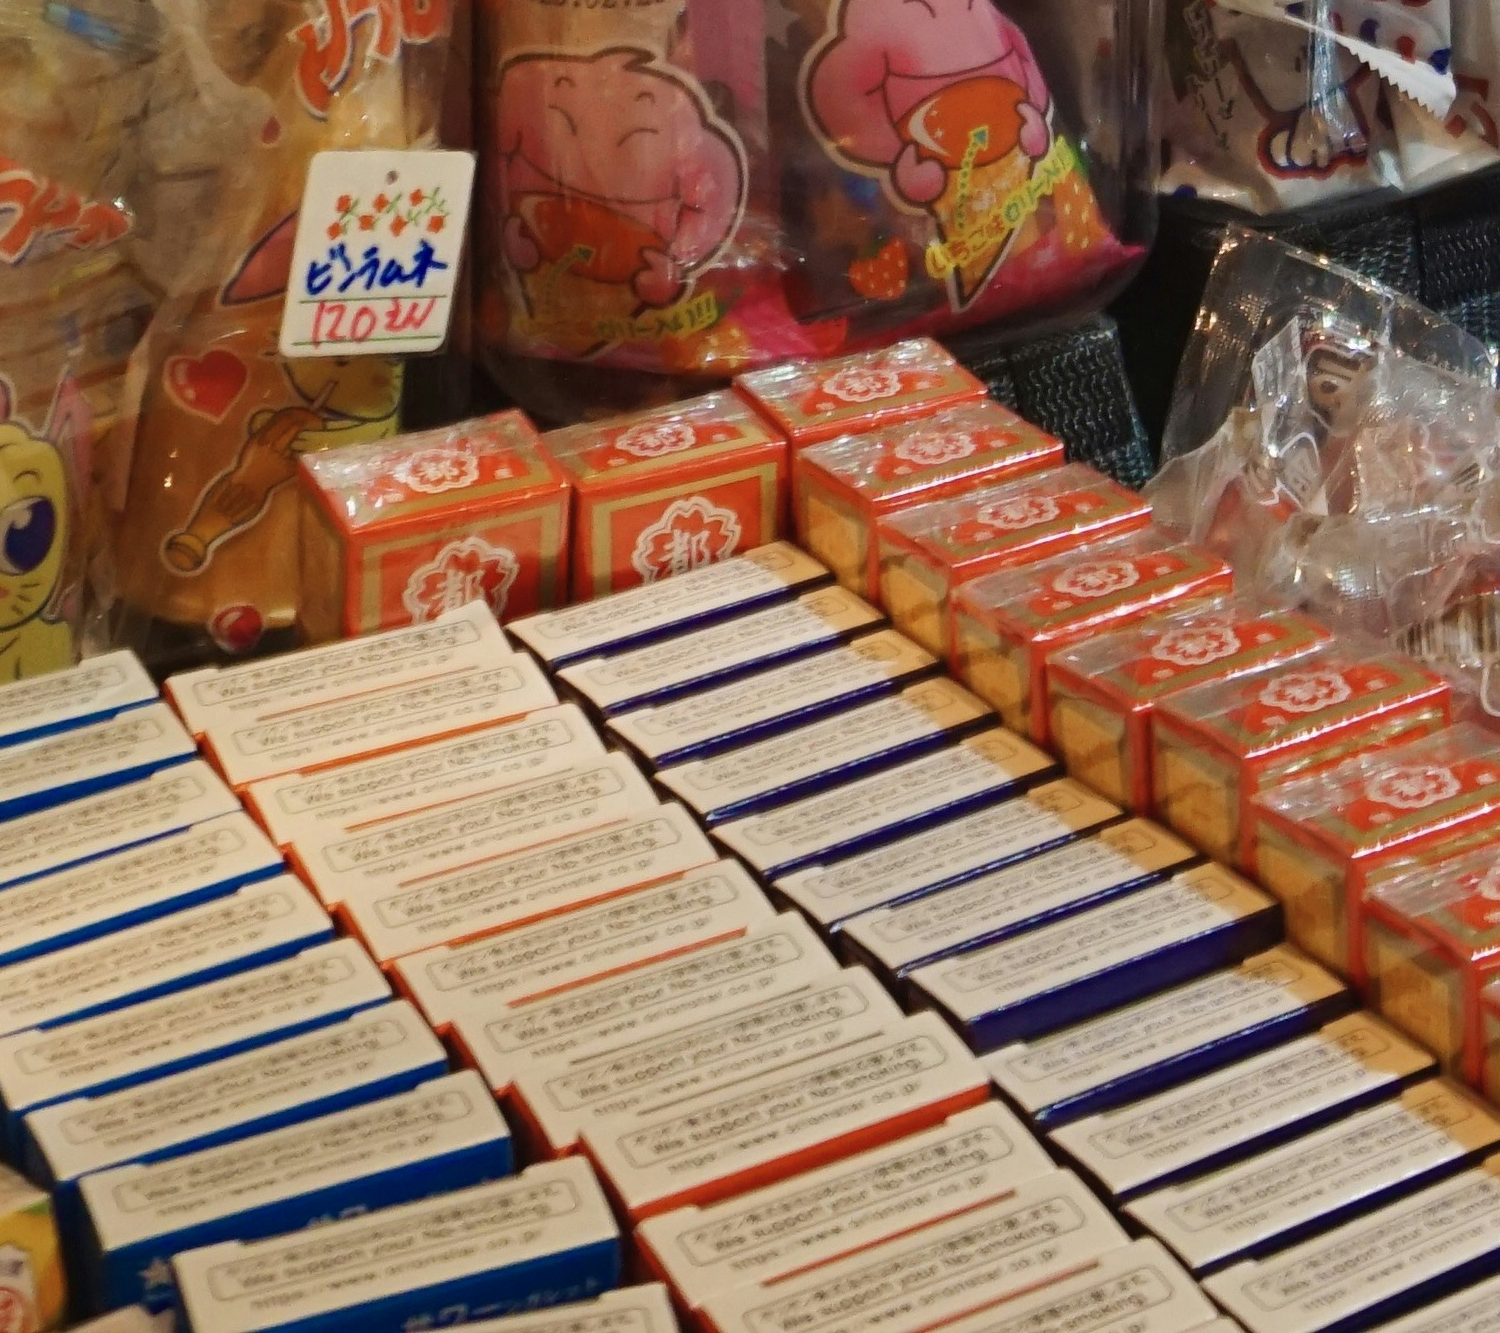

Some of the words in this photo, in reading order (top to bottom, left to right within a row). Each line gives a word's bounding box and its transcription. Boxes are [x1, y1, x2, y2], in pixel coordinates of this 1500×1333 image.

[303, 241, 448, 297] ビンラムネ
